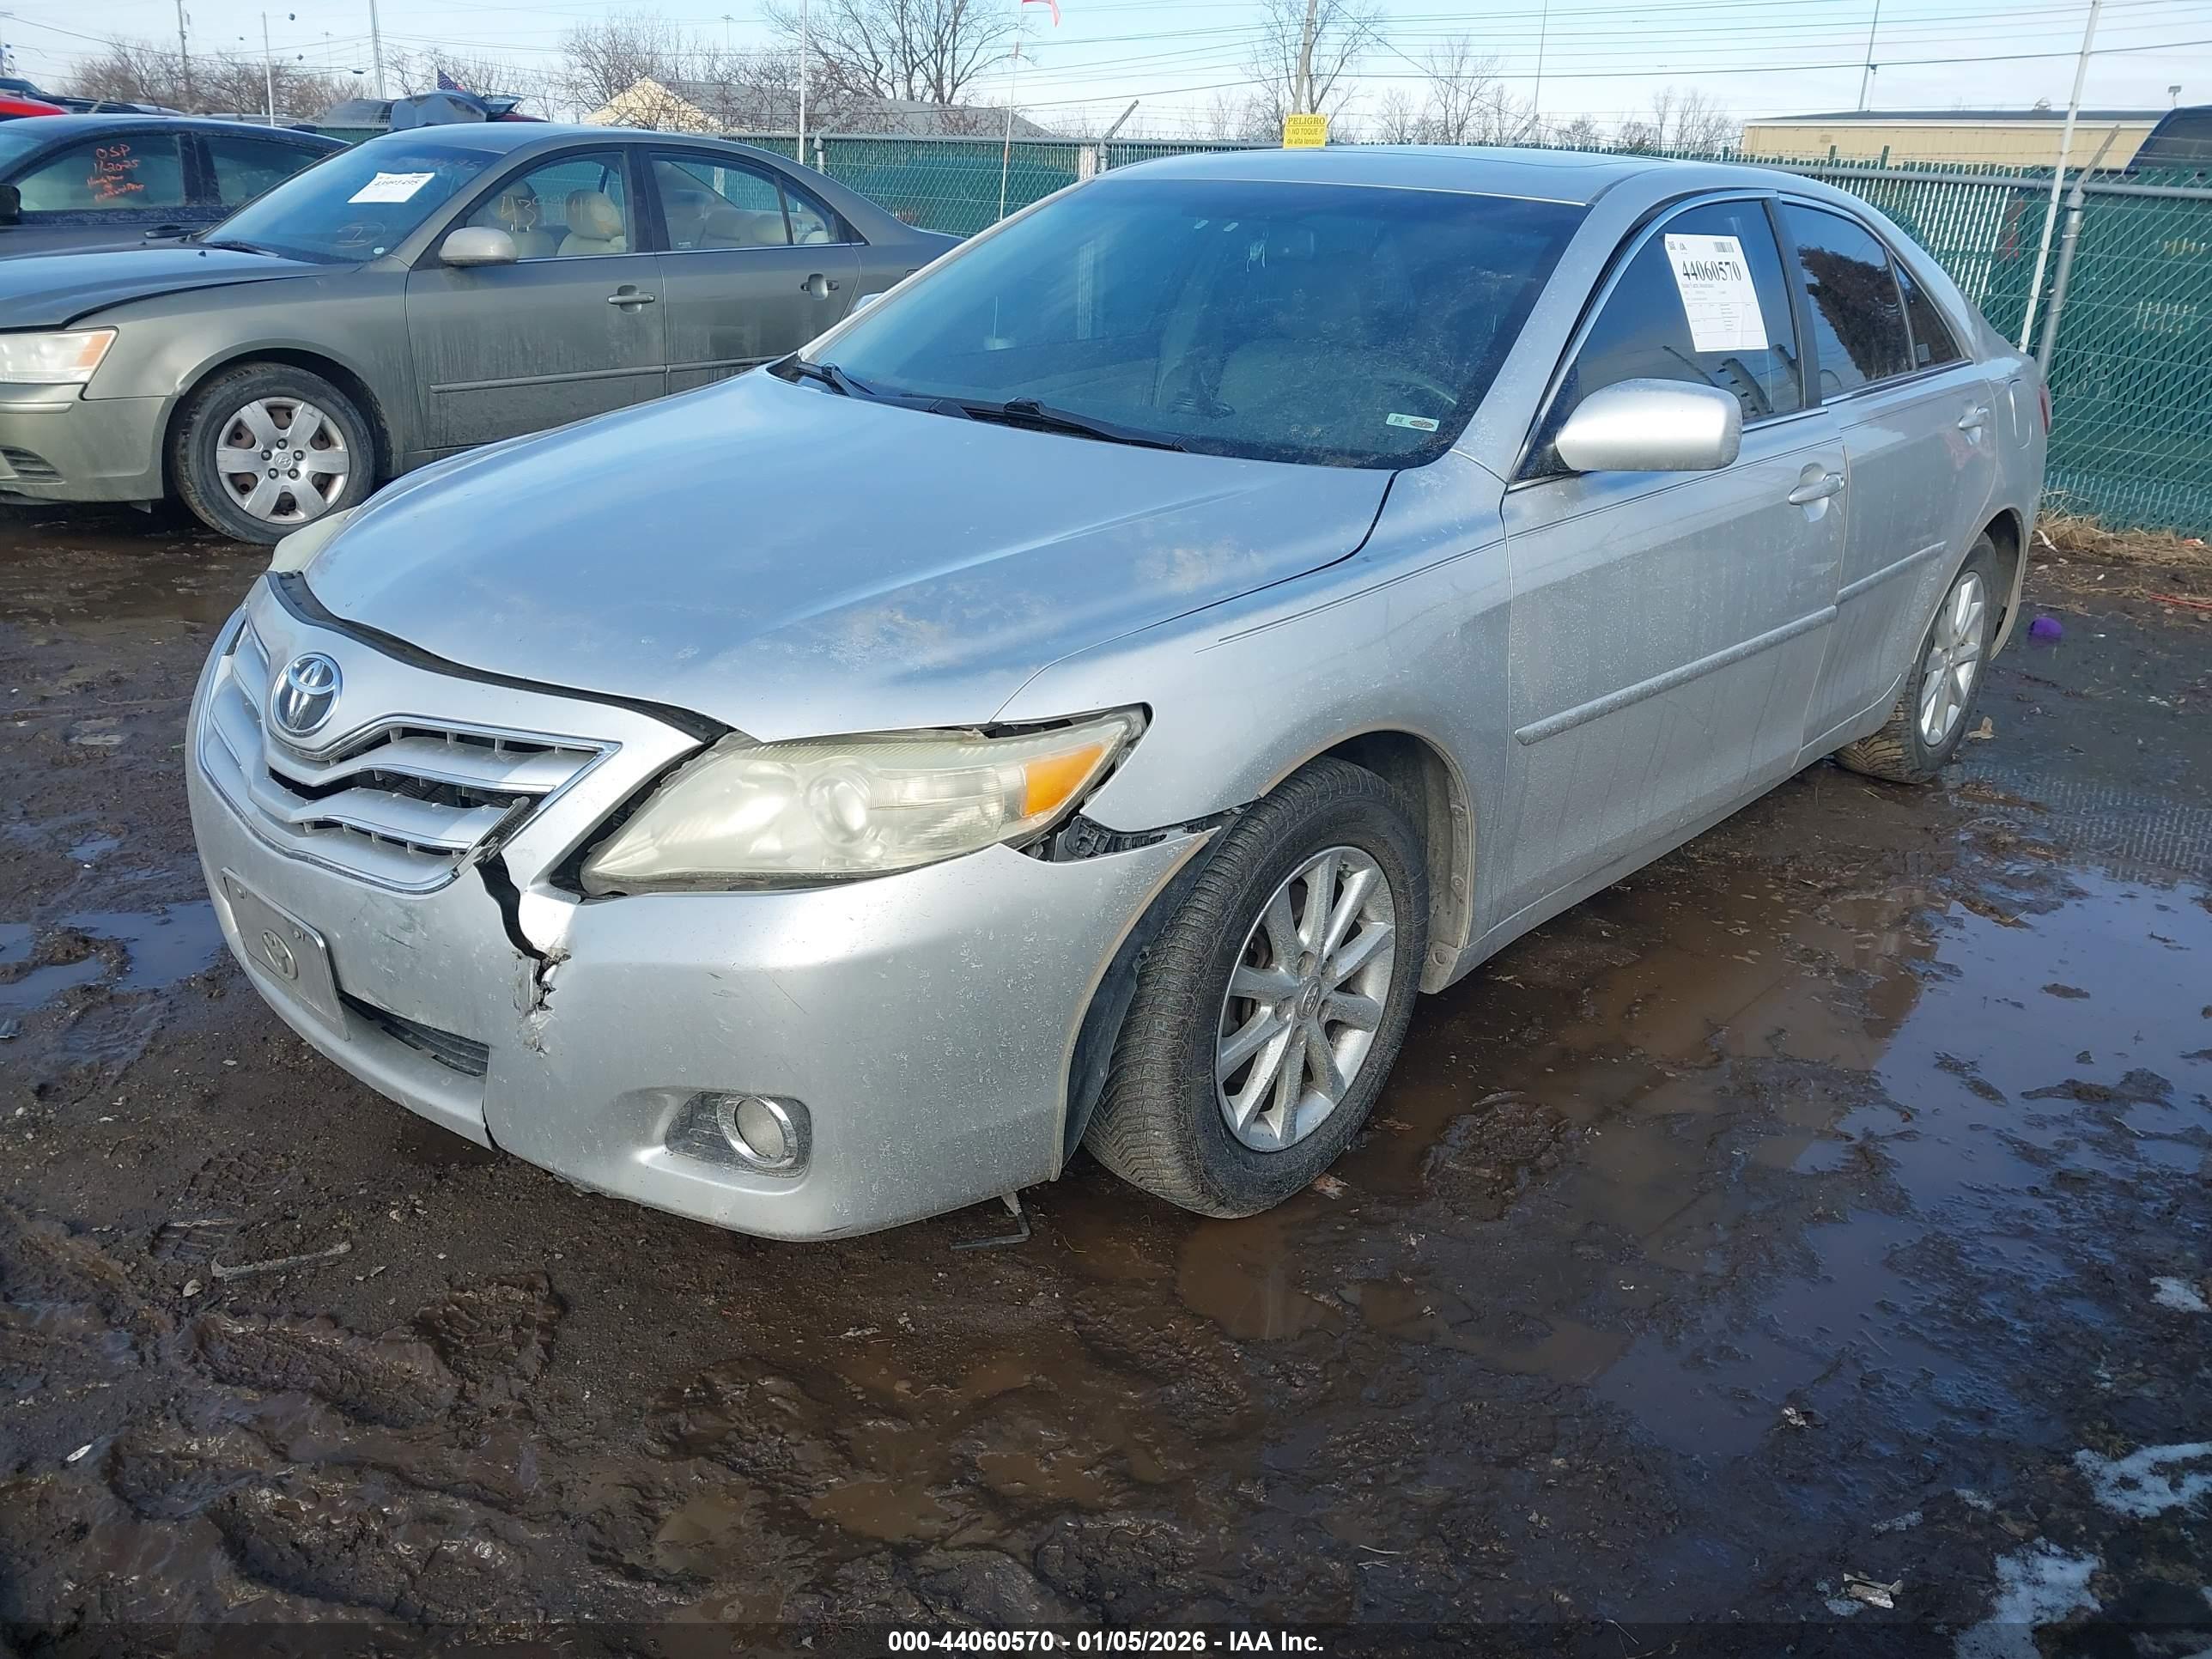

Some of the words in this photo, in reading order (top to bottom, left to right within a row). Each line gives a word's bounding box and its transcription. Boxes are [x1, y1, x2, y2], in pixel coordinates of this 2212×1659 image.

[1287, 117, 1326, 125] PELIGRO
[1291, 127, 1300, 136] NO
[1301, 127, 1319, 136] TOQUE
[95, 143, 131, 159] OSP
[1682, 260, 1741, 282] 44060570
